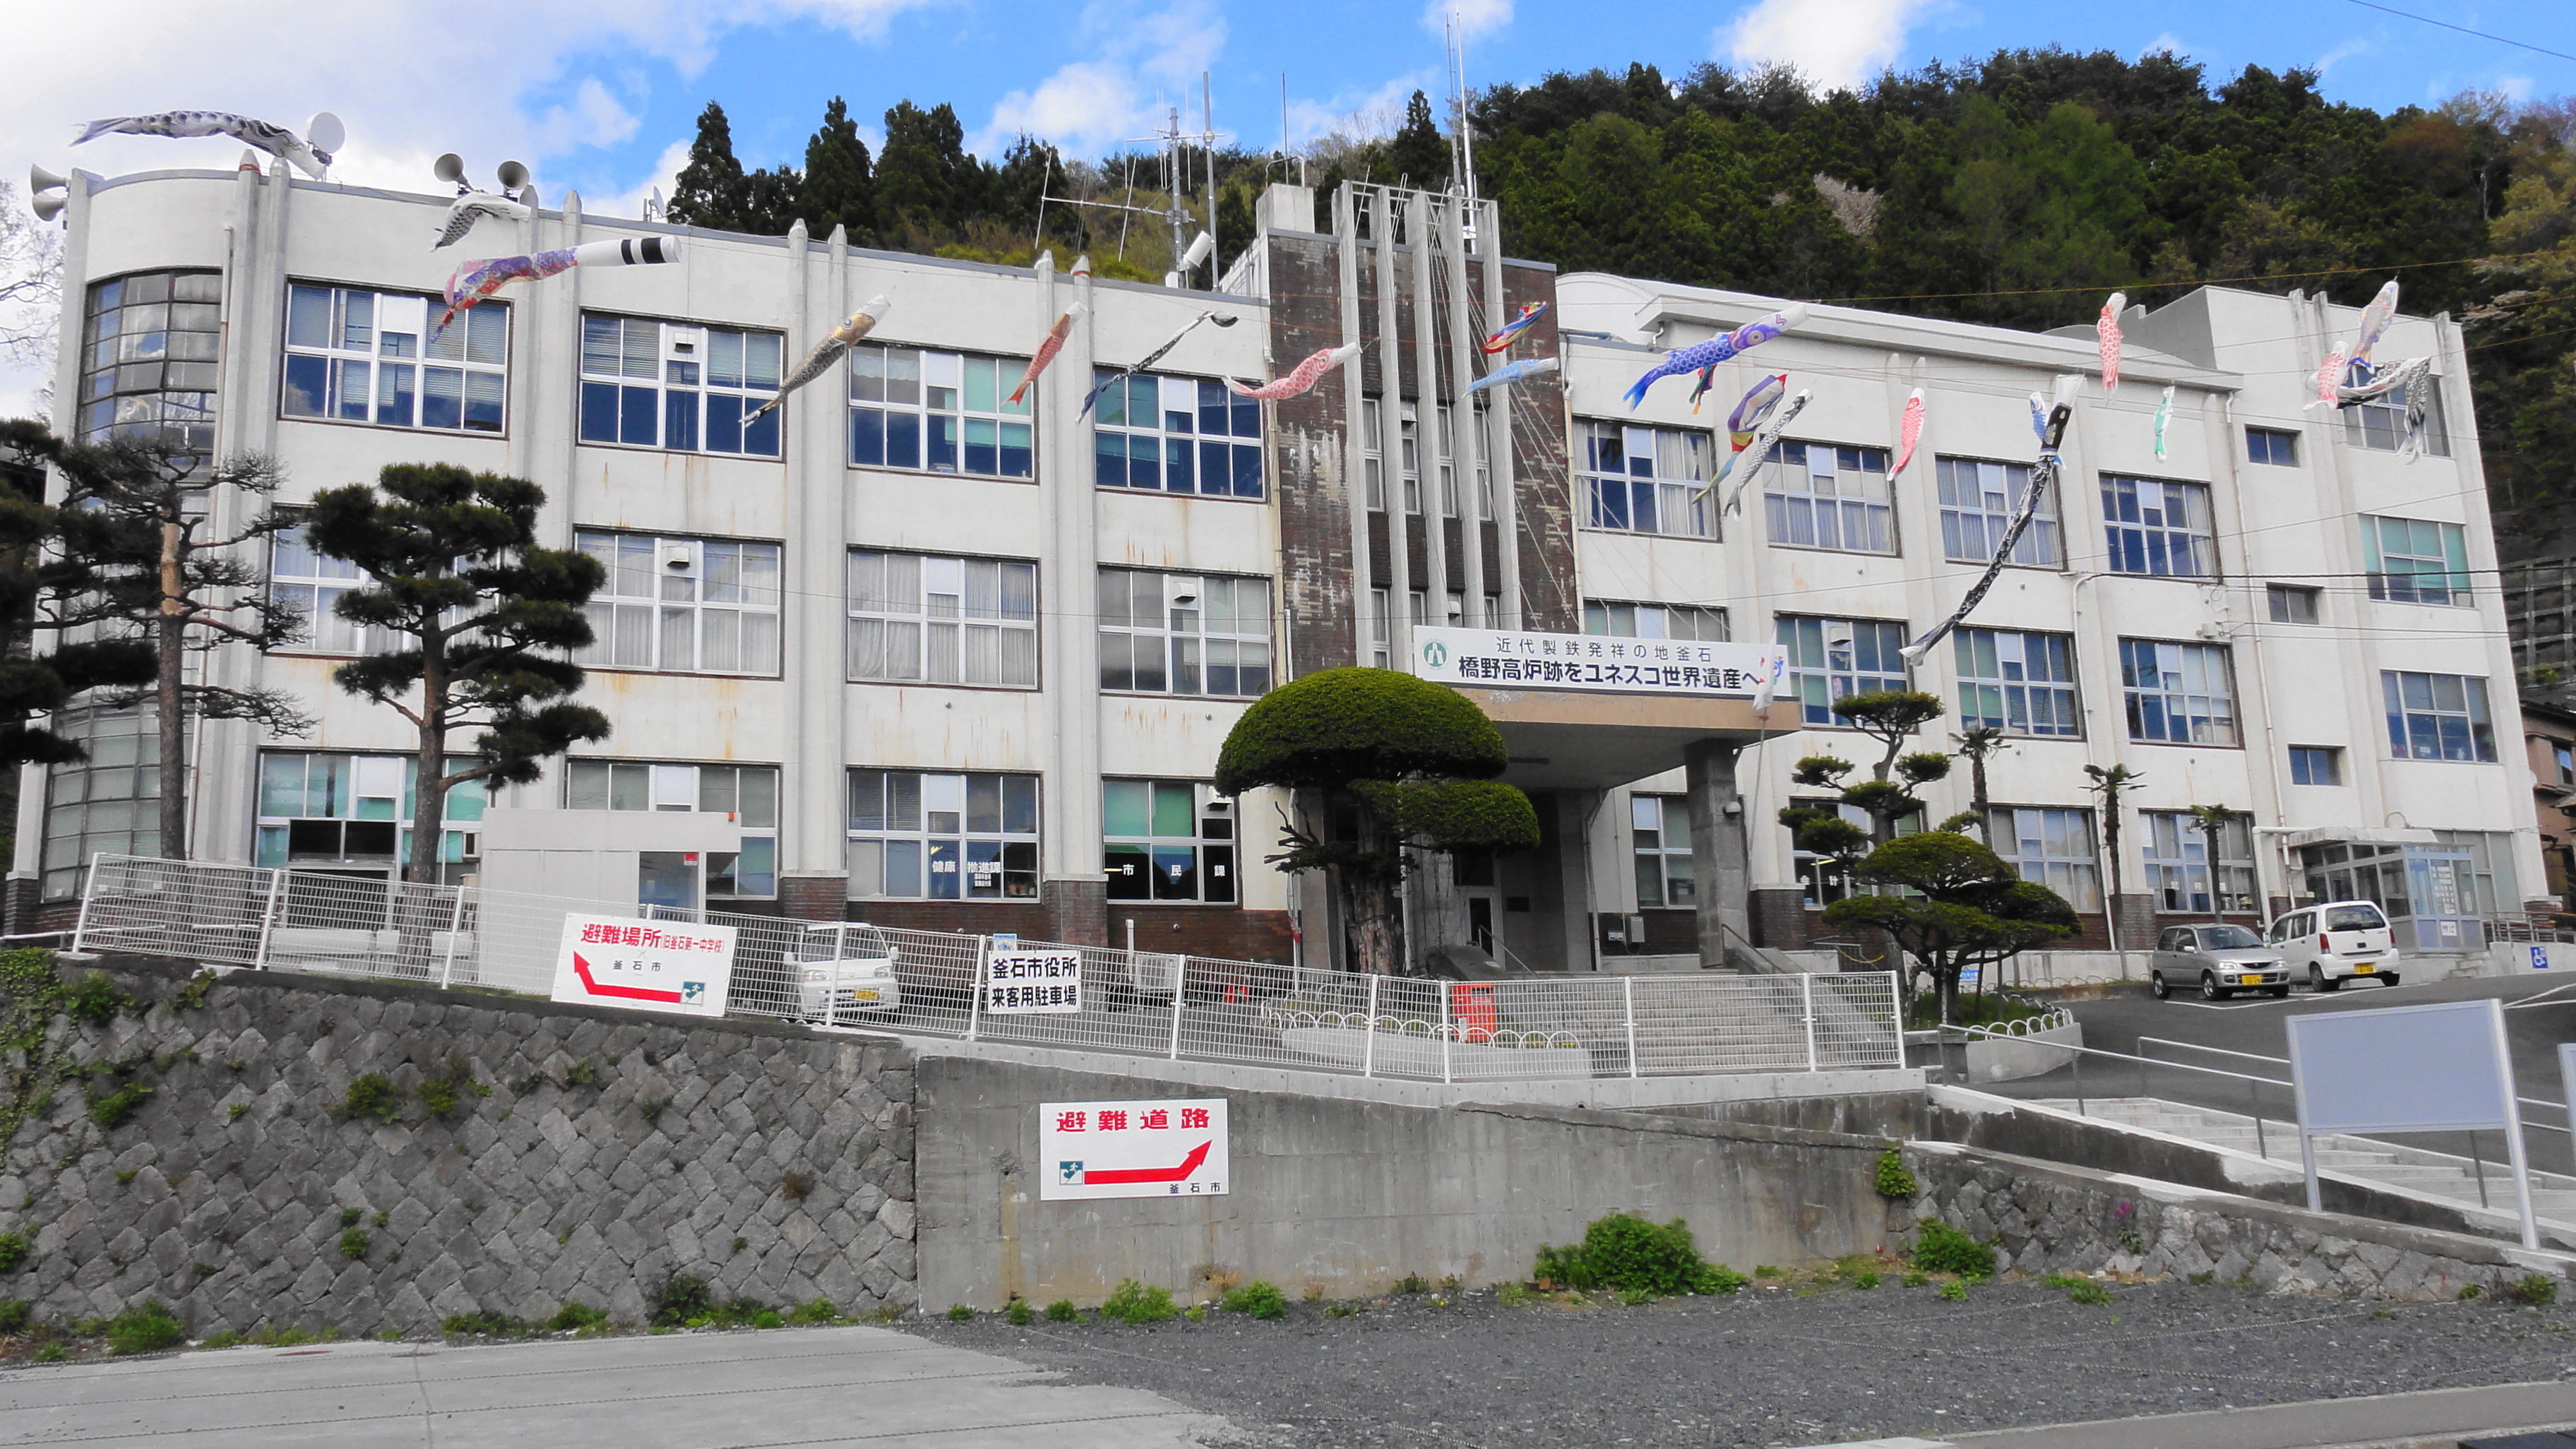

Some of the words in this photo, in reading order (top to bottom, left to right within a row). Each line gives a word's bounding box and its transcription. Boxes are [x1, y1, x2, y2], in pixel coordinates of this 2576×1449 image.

[1496, 636, 1711, 662] 近代製鉄発祥の地釜石
[1458, 656, 1760, 690] 橋野高炉跡をユネスコ世界遺産へ
[932, 861, 956, 873] 健康
[580, 924, 662, 948] 避難場所
[613, 960, 662, 972] 釜石市
[992, 956, 1077, 979] 釜石市役所
[991, 985, 1077, 1008] 来客用駐車場
[1056, 1108, 1210, 1133] 避難道路
[1169, 1182, 1221, 1194] 釜石市
